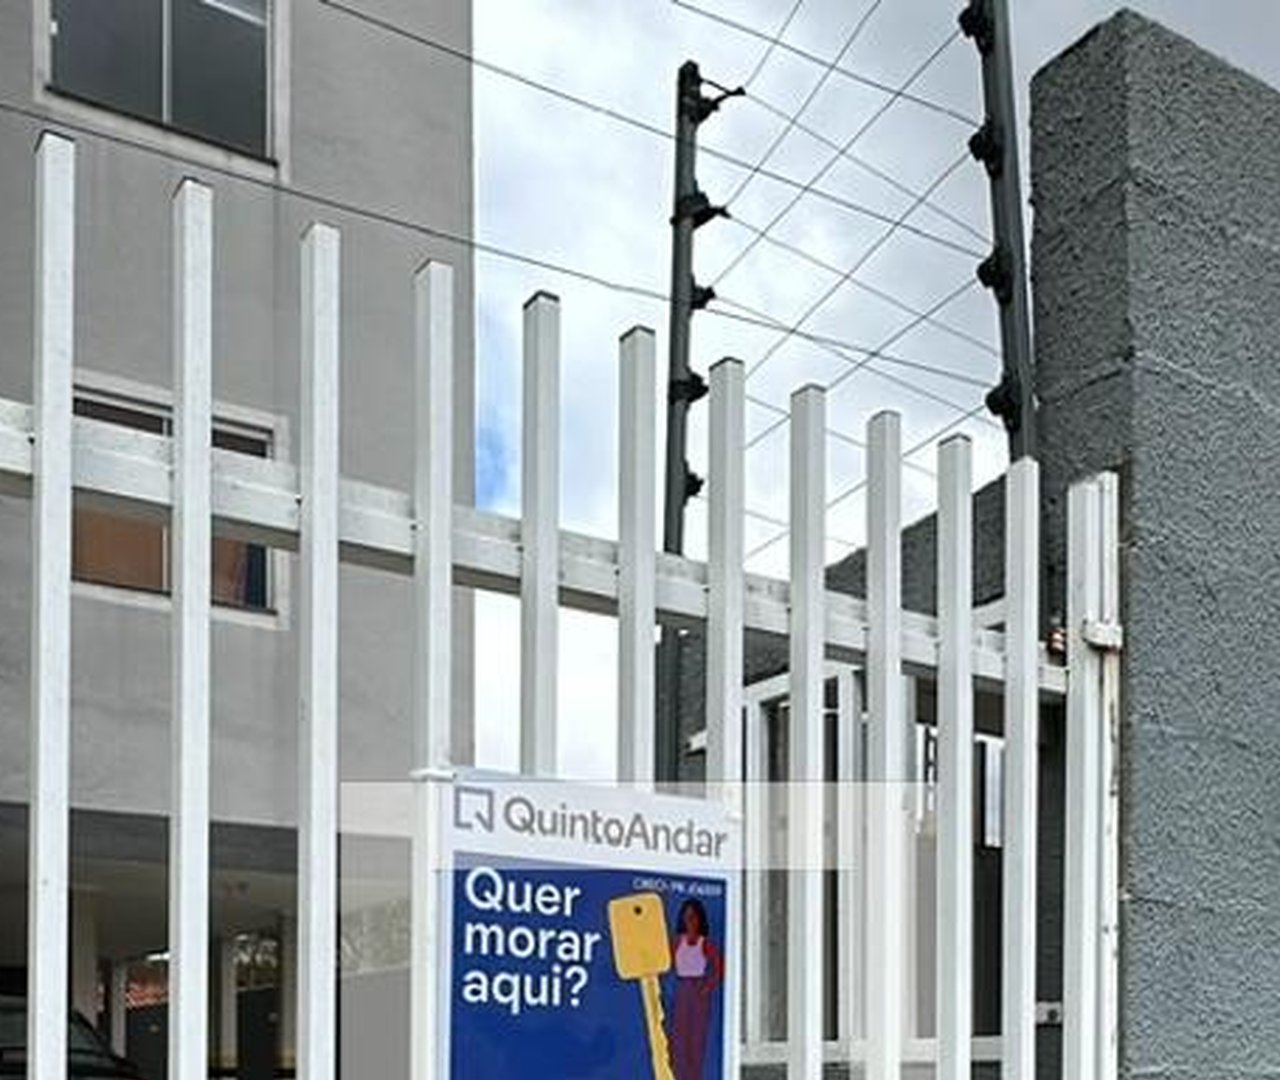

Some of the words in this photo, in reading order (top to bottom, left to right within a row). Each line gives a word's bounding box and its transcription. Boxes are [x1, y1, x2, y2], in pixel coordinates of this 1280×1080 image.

[504, 796, 727, 858] QuintoAndar
[466, 866, 581, 916] Quer
[464, 922, 601, 963] morar
[462, 962, 589, 1015] aqui?
